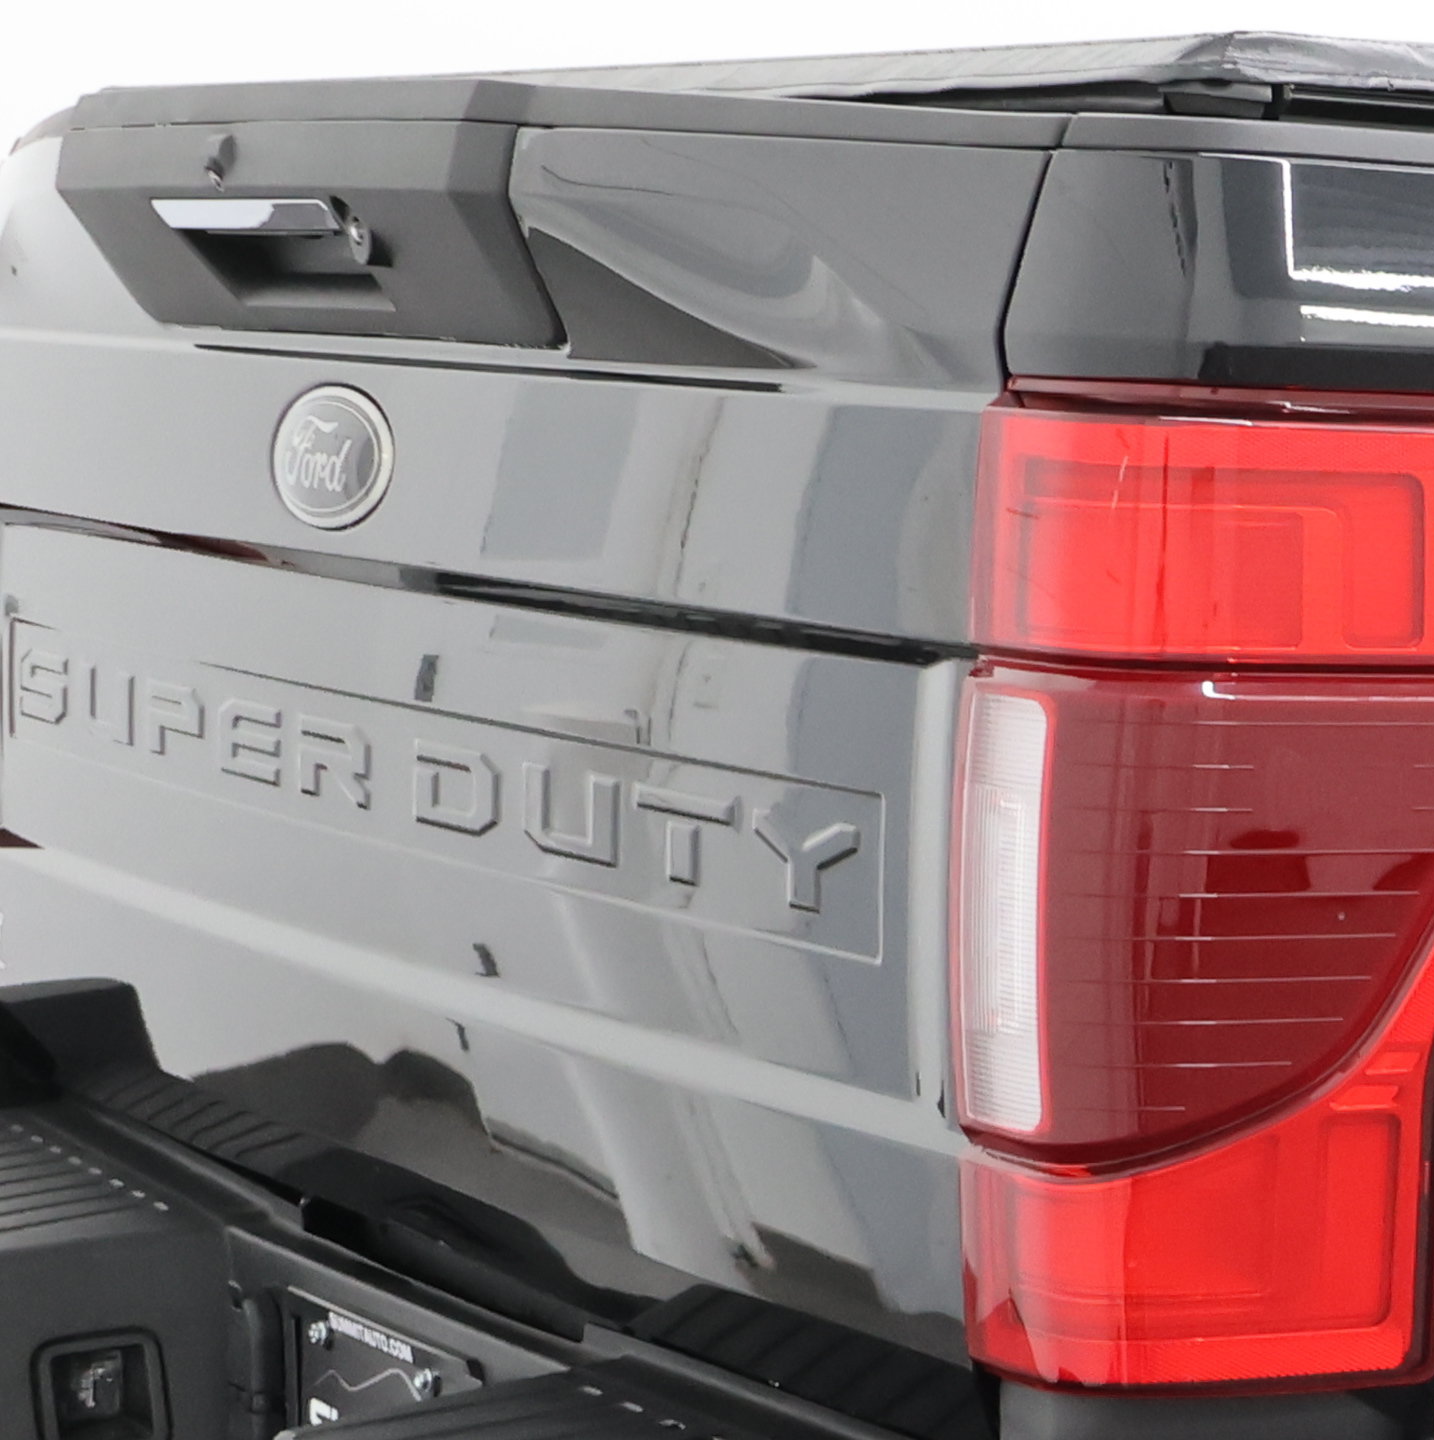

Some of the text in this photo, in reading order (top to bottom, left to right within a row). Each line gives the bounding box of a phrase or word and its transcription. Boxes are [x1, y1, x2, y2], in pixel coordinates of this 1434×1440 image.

[285, 414, 352, 492] Ford
[18, 647, 861, 914] SUPER DUTY
